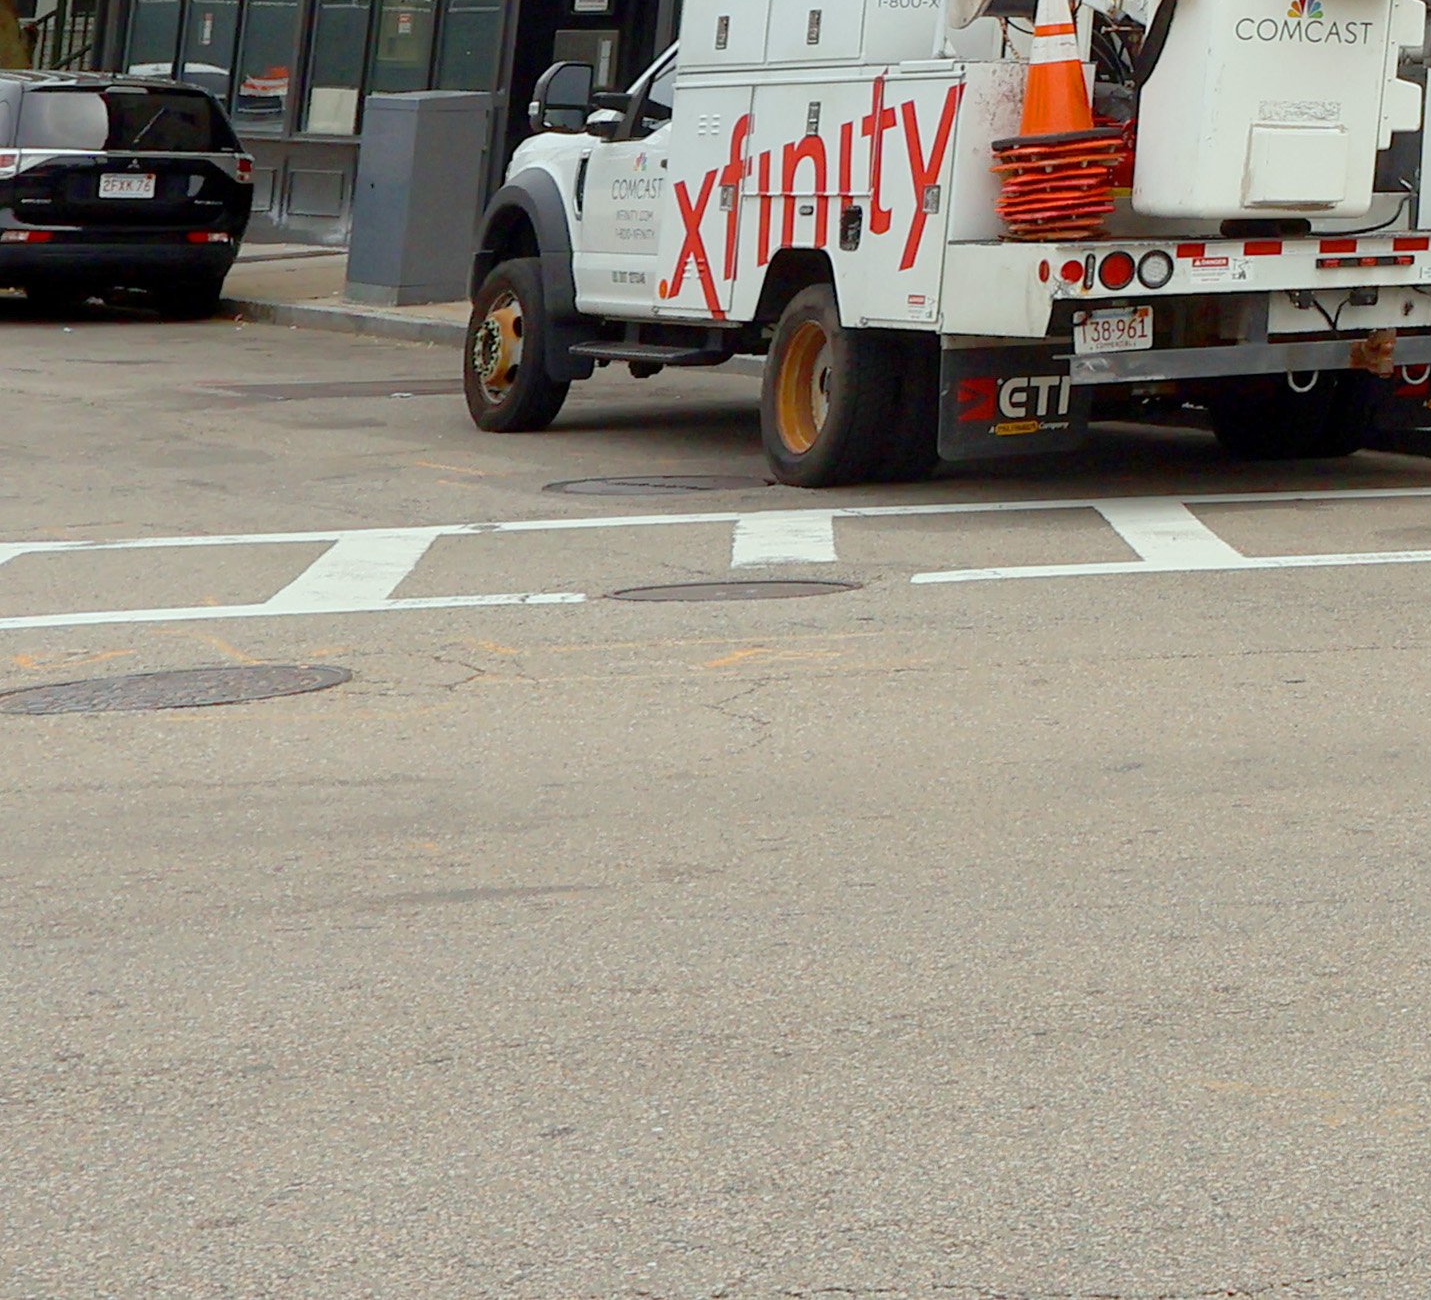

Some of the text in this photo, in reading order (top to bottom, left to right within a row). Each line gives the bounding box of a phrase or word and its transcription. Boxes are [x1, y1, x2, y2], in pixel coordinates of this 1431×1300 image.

[1235, 18, 1373, 44] COMCAST
[612, 178, 664, 200] COMCAST
[668, 68, 966, 320] xfinity
[1000, 375, 1070, 418] ETI
